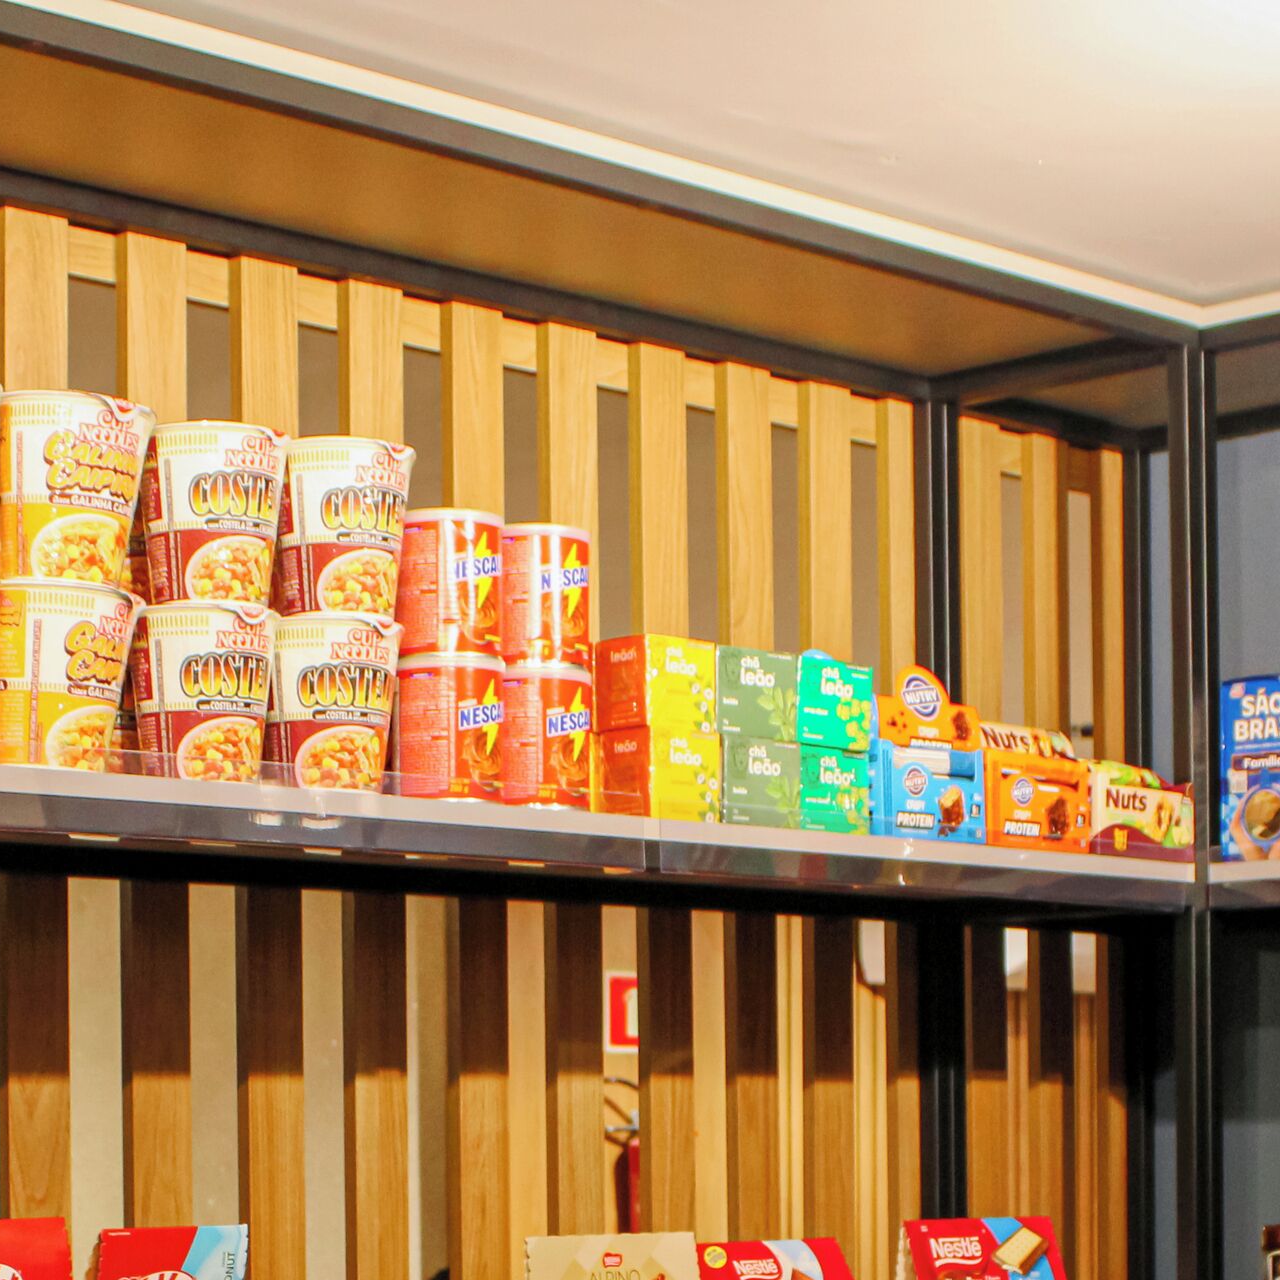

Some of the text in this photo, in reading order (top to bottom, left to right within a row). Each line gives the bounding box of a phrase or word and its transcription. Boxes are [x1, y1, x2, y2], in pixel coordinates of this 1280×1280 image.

[188, 470, 278, 518] COSTE
[331, 643, 389, 664] NOODLES
[740, 669, 775, 687] leão
[905, 687, 939, 706] NUTRY
[459, 702, 503, 729] NESCA
[982, 727, 1030, 751] Nuts
[749, 759, 780, 776] leão
[1106, 787, 1147, 811] Nuts
[897, 812, 934, 829] PROTEIN
[1005, 822, 1040, 837] PROTEIN
